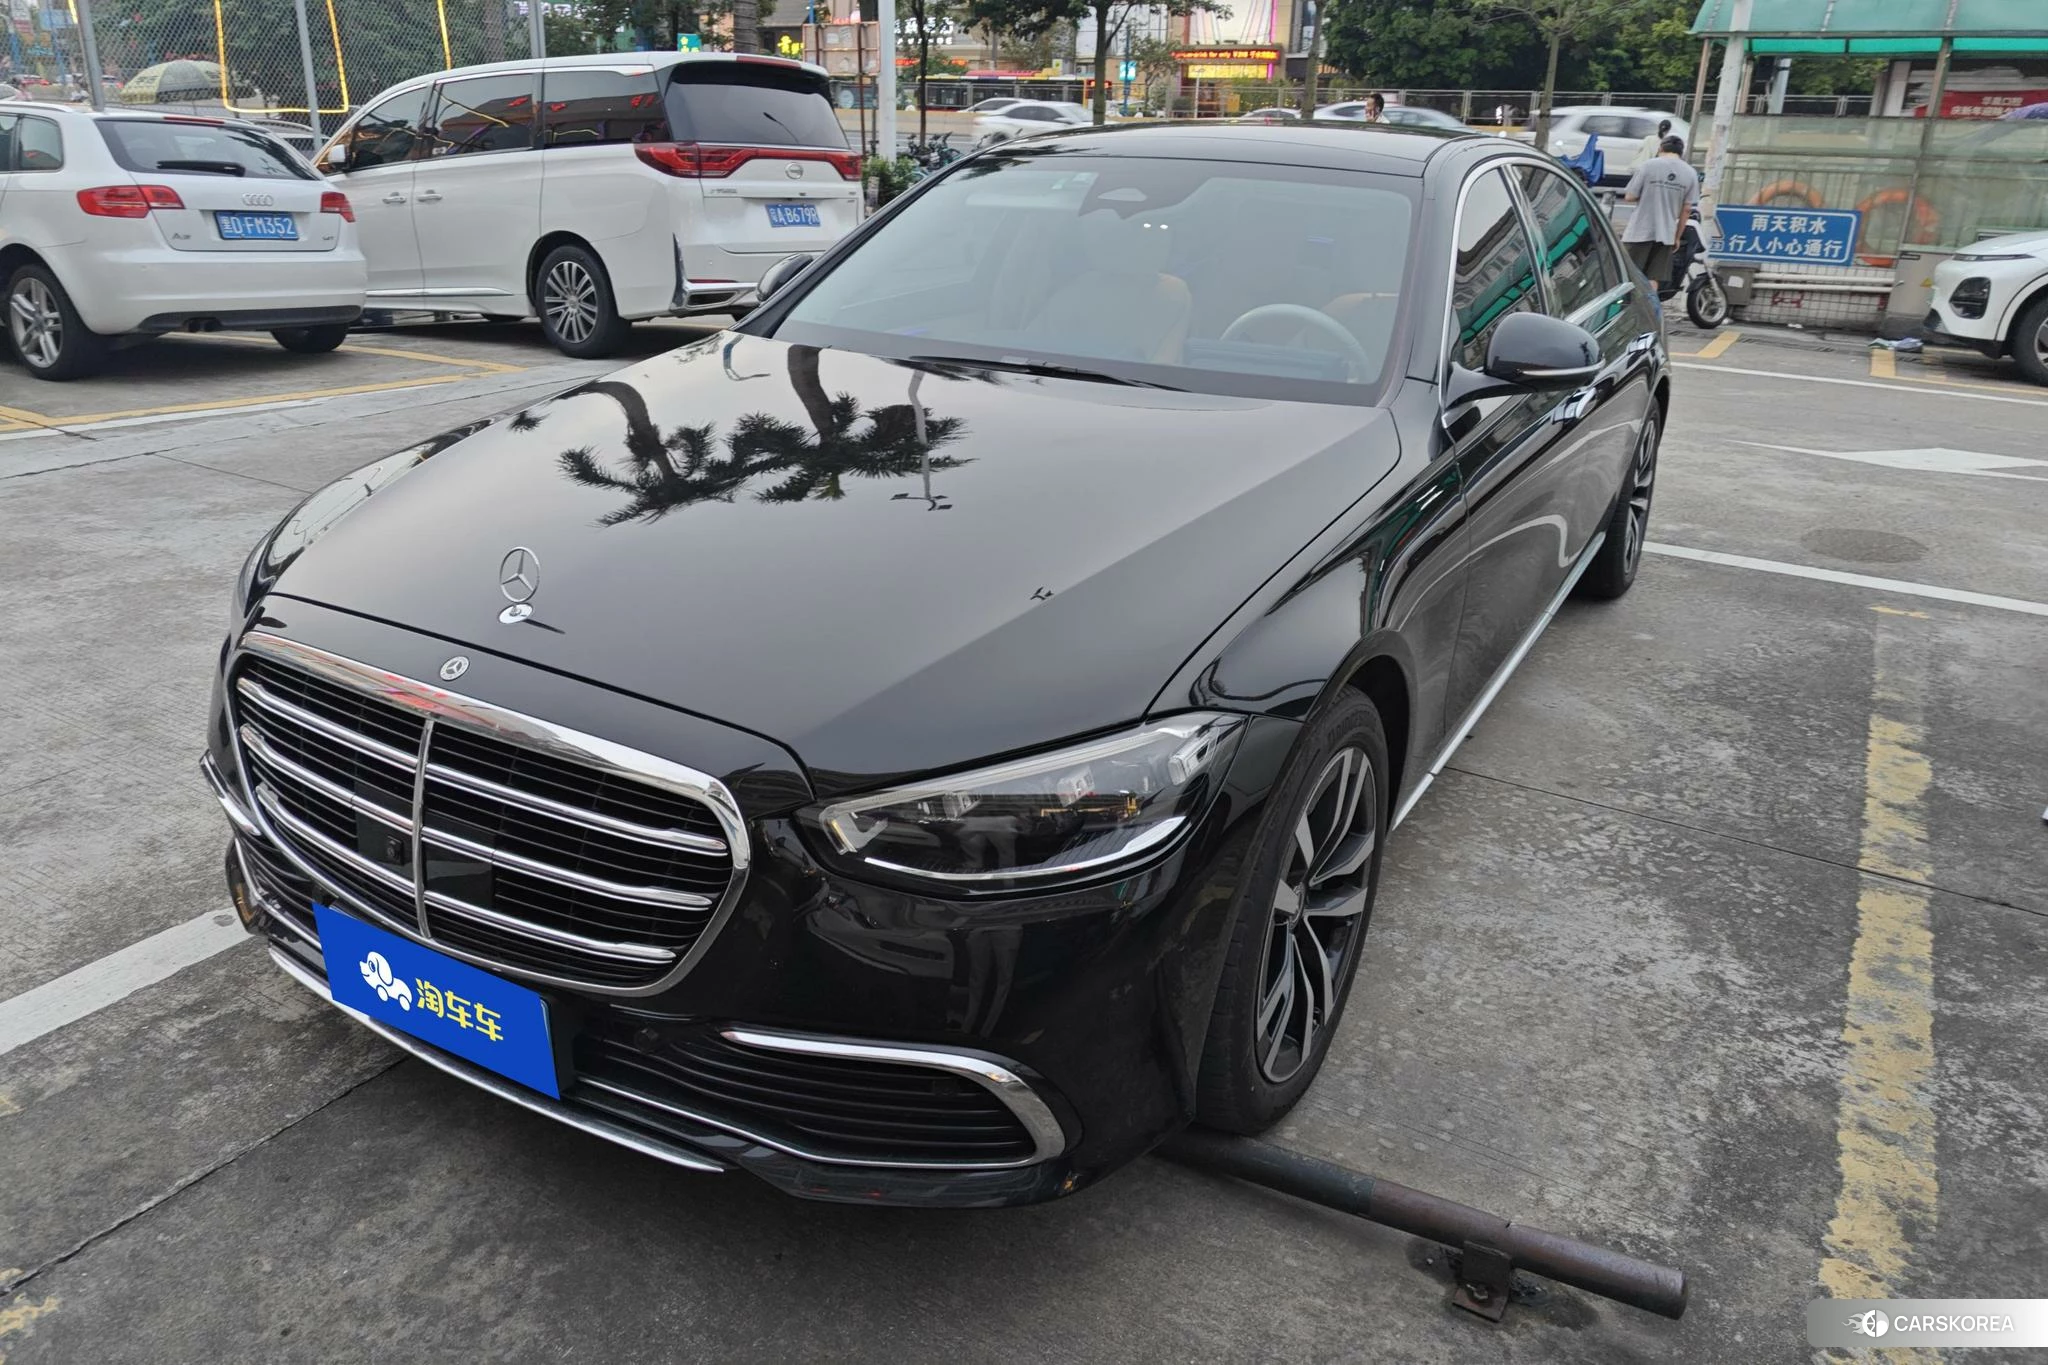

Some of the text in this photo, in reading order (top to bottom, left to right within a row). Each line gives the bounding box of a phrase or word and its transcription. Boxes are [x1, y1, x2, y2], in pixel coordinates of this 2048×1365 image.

[1751, 214, 1828, 235] 雨天积水
[1728, 234, 1844, 259] 行人小心通行
[416, 977, 504, 1042] 淘车车
